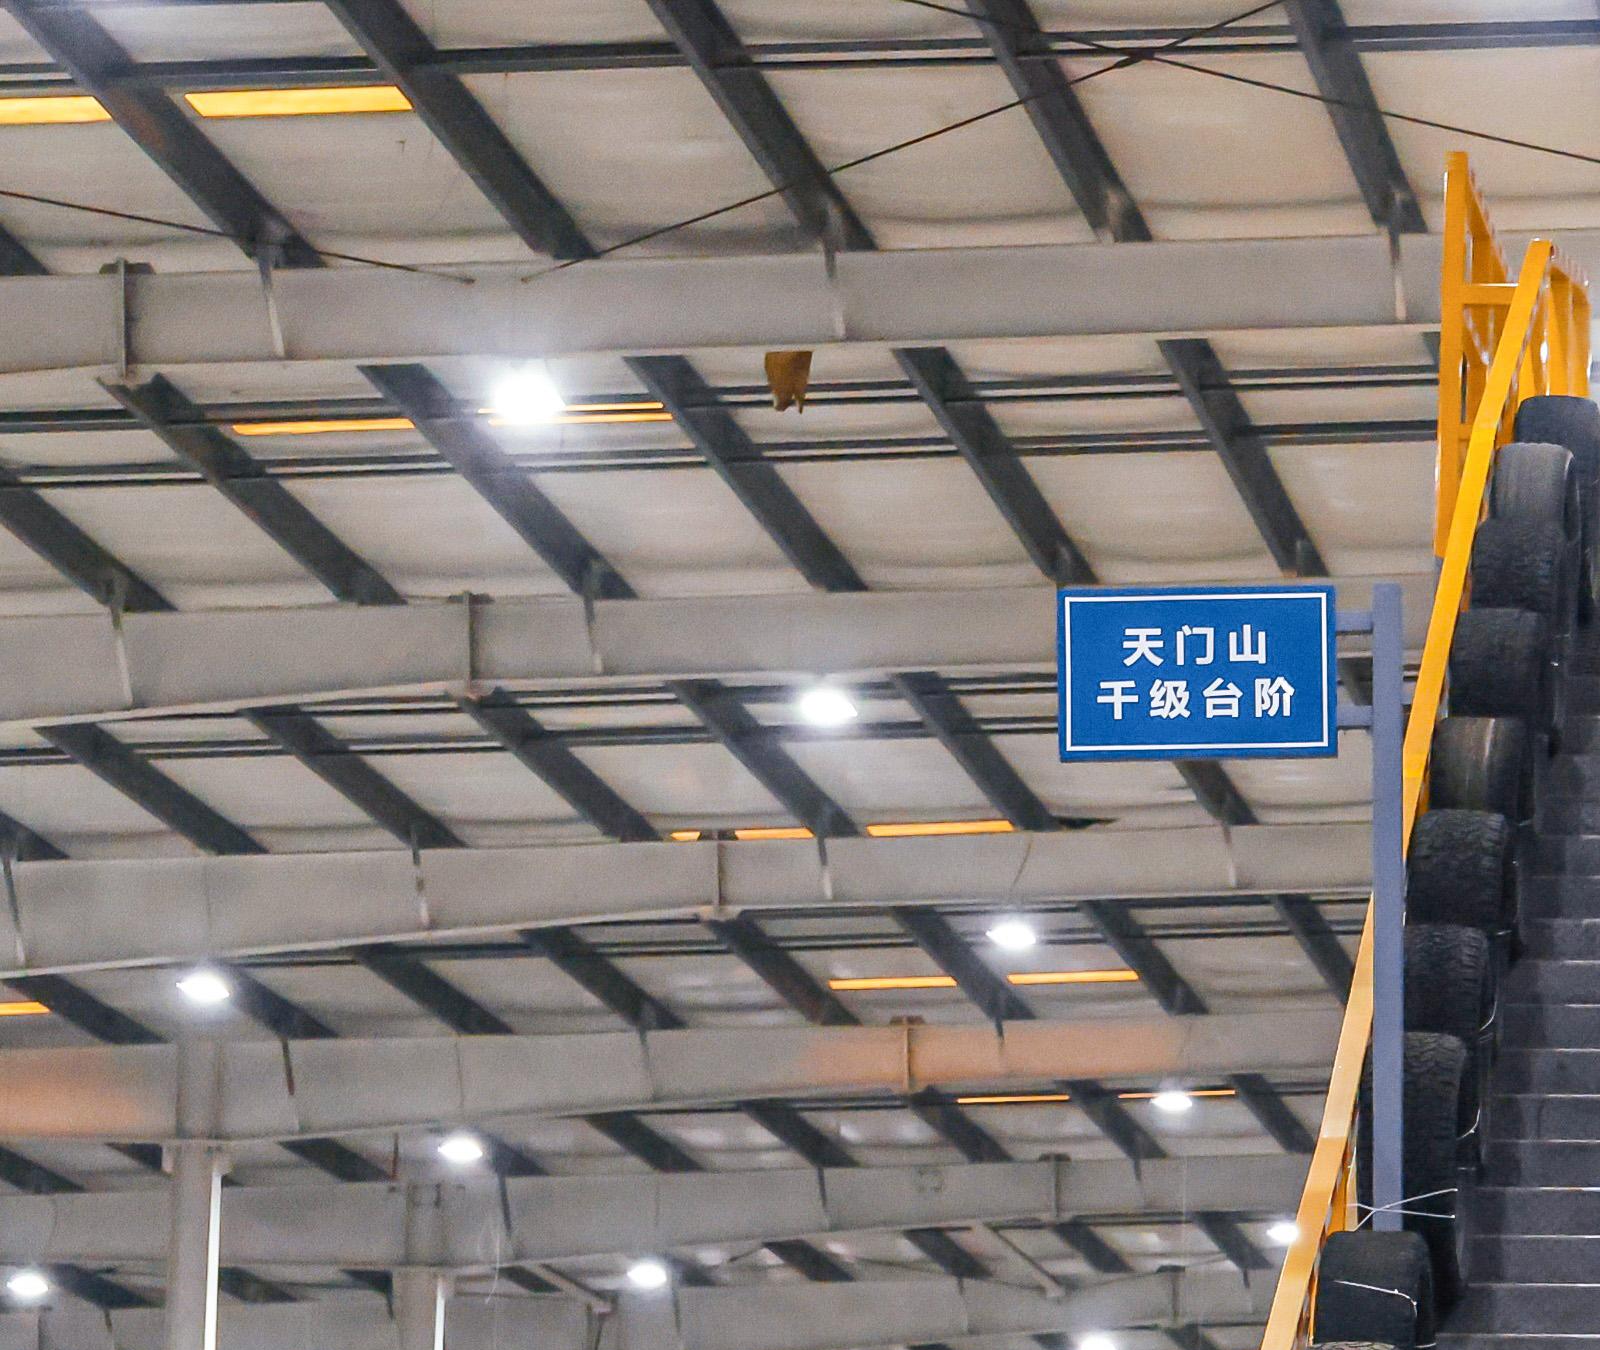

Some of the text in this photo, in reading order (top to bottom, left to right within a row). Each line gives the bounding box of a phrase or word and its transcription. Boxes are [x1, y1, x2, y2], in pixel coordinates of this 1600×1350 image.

[1122, 624, 1267, 667] 天门山
[1096, 676, 1296, 720] 千级台阶
